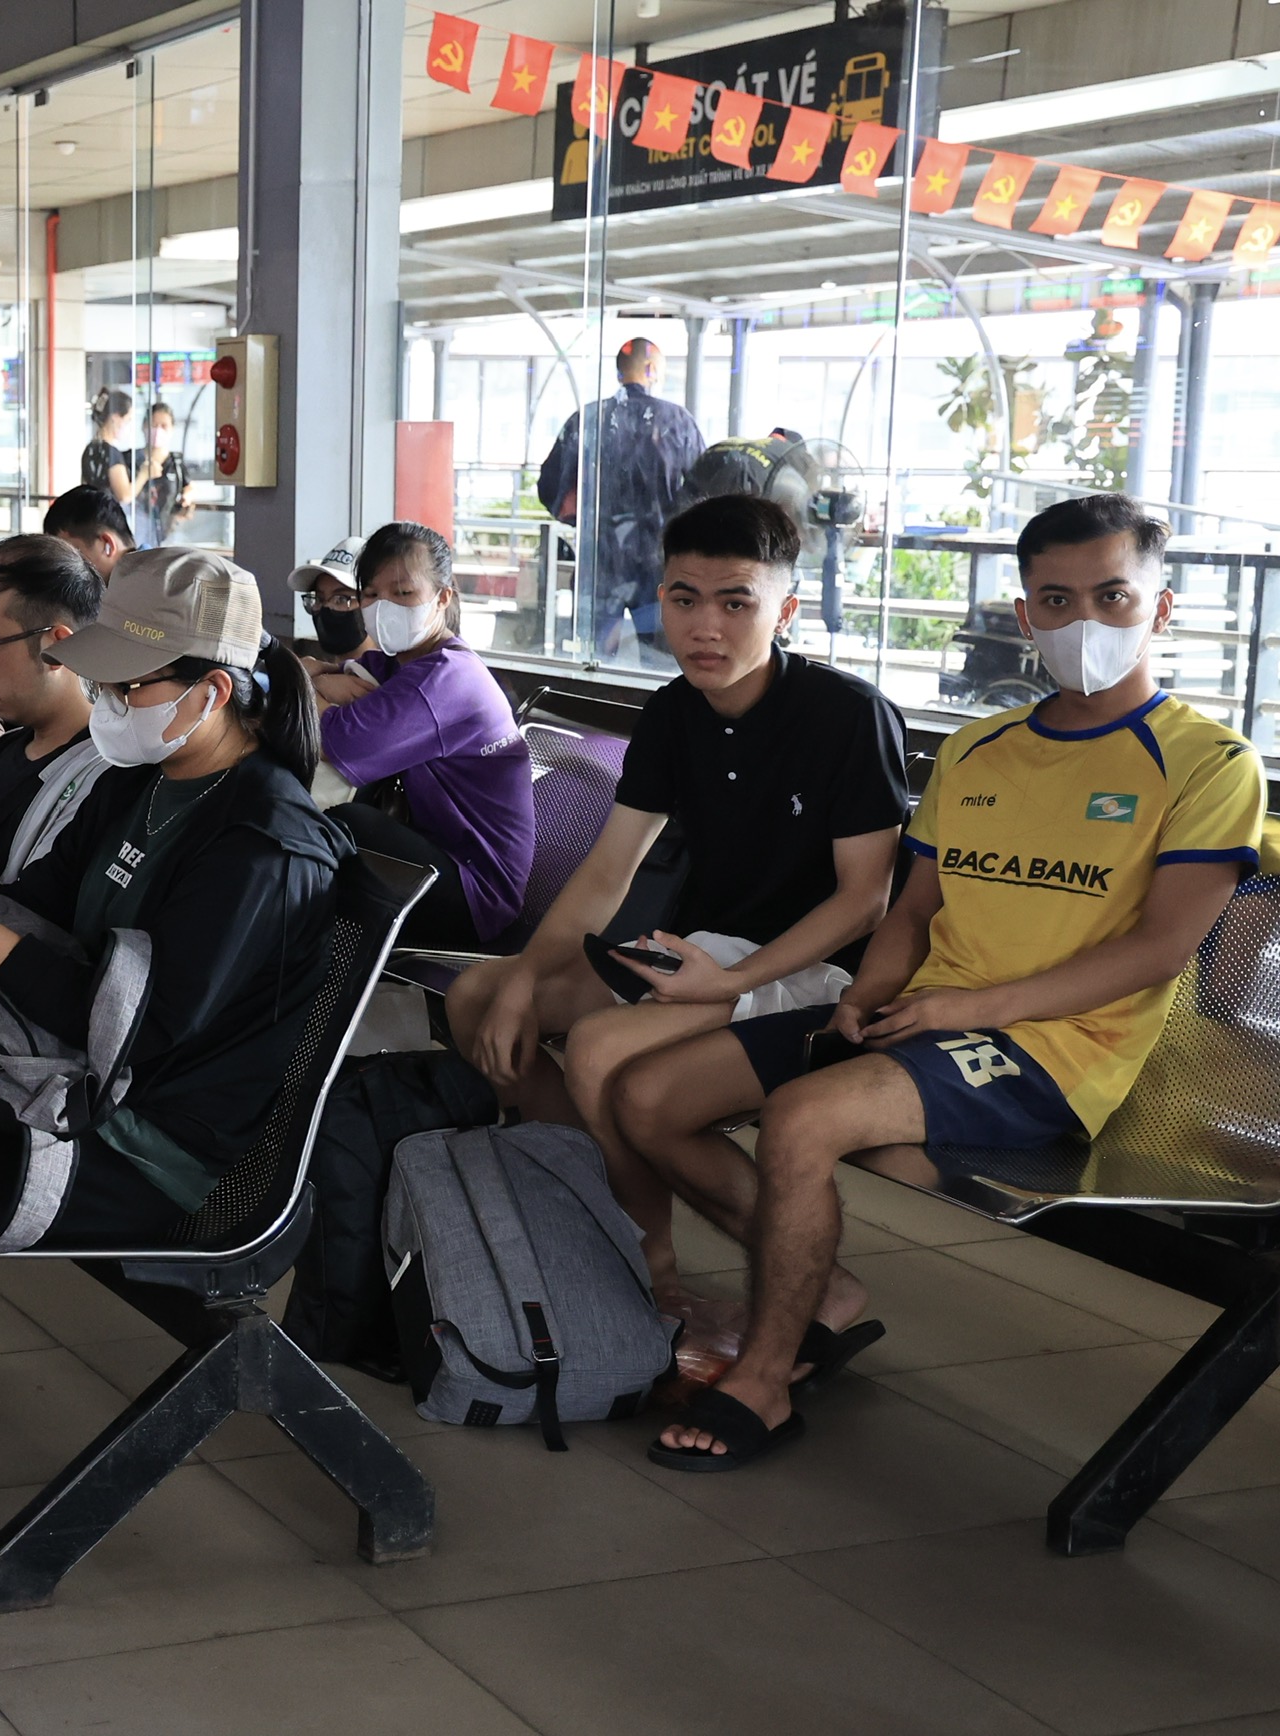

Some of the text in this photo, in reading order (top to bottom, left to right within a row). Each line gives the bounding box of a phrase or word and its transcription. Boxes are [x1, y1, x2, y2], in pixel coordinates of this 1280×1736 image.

[778, 48, 817, 107] VÉ
[123, 620, 165, 641] POLYTOP
[117, 840, 146, 868] REE
[942, 848, 1114, 892] BAC A BANK
[935, 1032, 1021, 1088] 18
